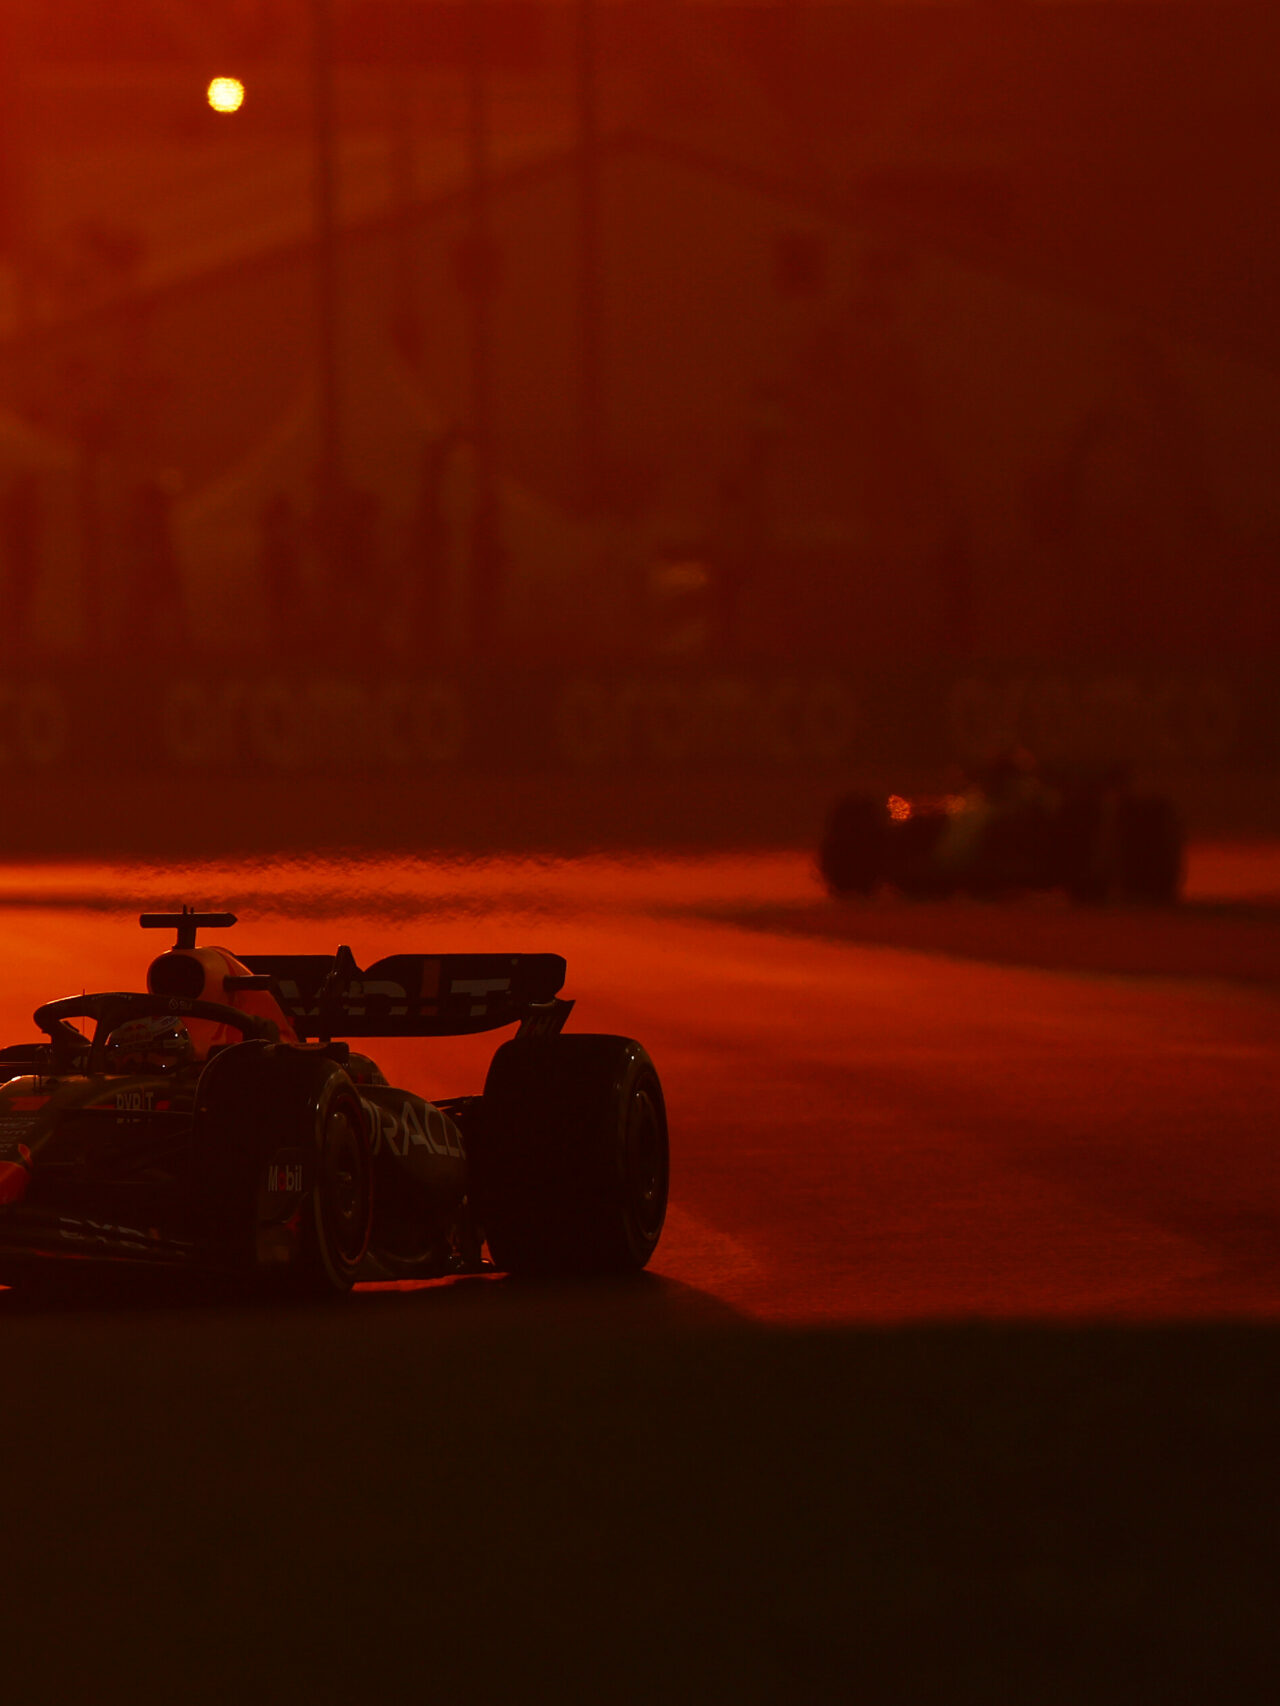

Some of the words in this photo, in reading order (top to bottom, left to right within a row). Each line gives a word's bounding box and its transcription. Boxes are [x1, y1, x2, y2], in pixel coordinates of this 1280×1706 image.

[166, 678, 468, 765] aramco
[553, 676, 860, 764] aramco
[946, 675, 1241, 763] aramco
